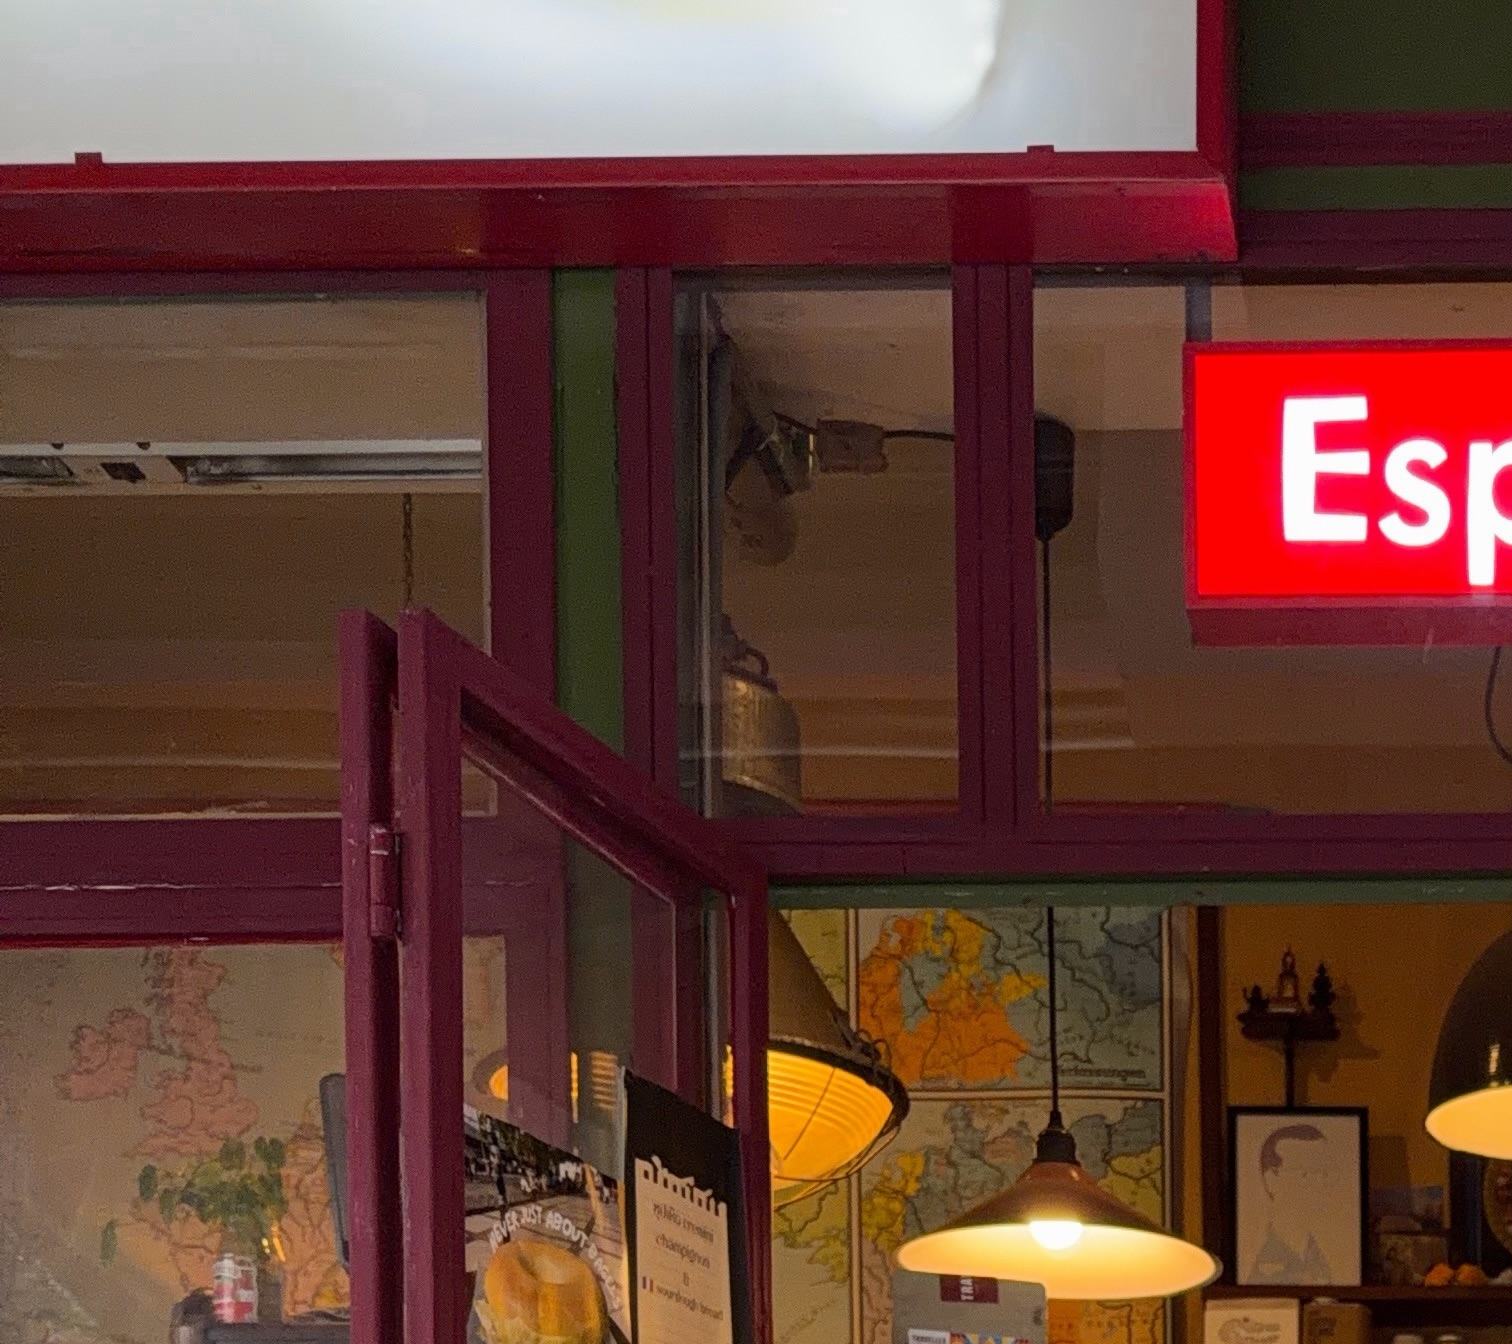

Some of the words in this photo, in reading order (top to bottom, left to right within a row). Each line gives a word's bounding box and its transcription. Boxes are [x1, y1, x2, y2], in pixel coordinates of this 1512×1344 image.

[489, 1210, 520, 1252] NEVER
[521, 1206, 542, 1224] JUST
[545, 1211, 588, 1249] ABOUT
